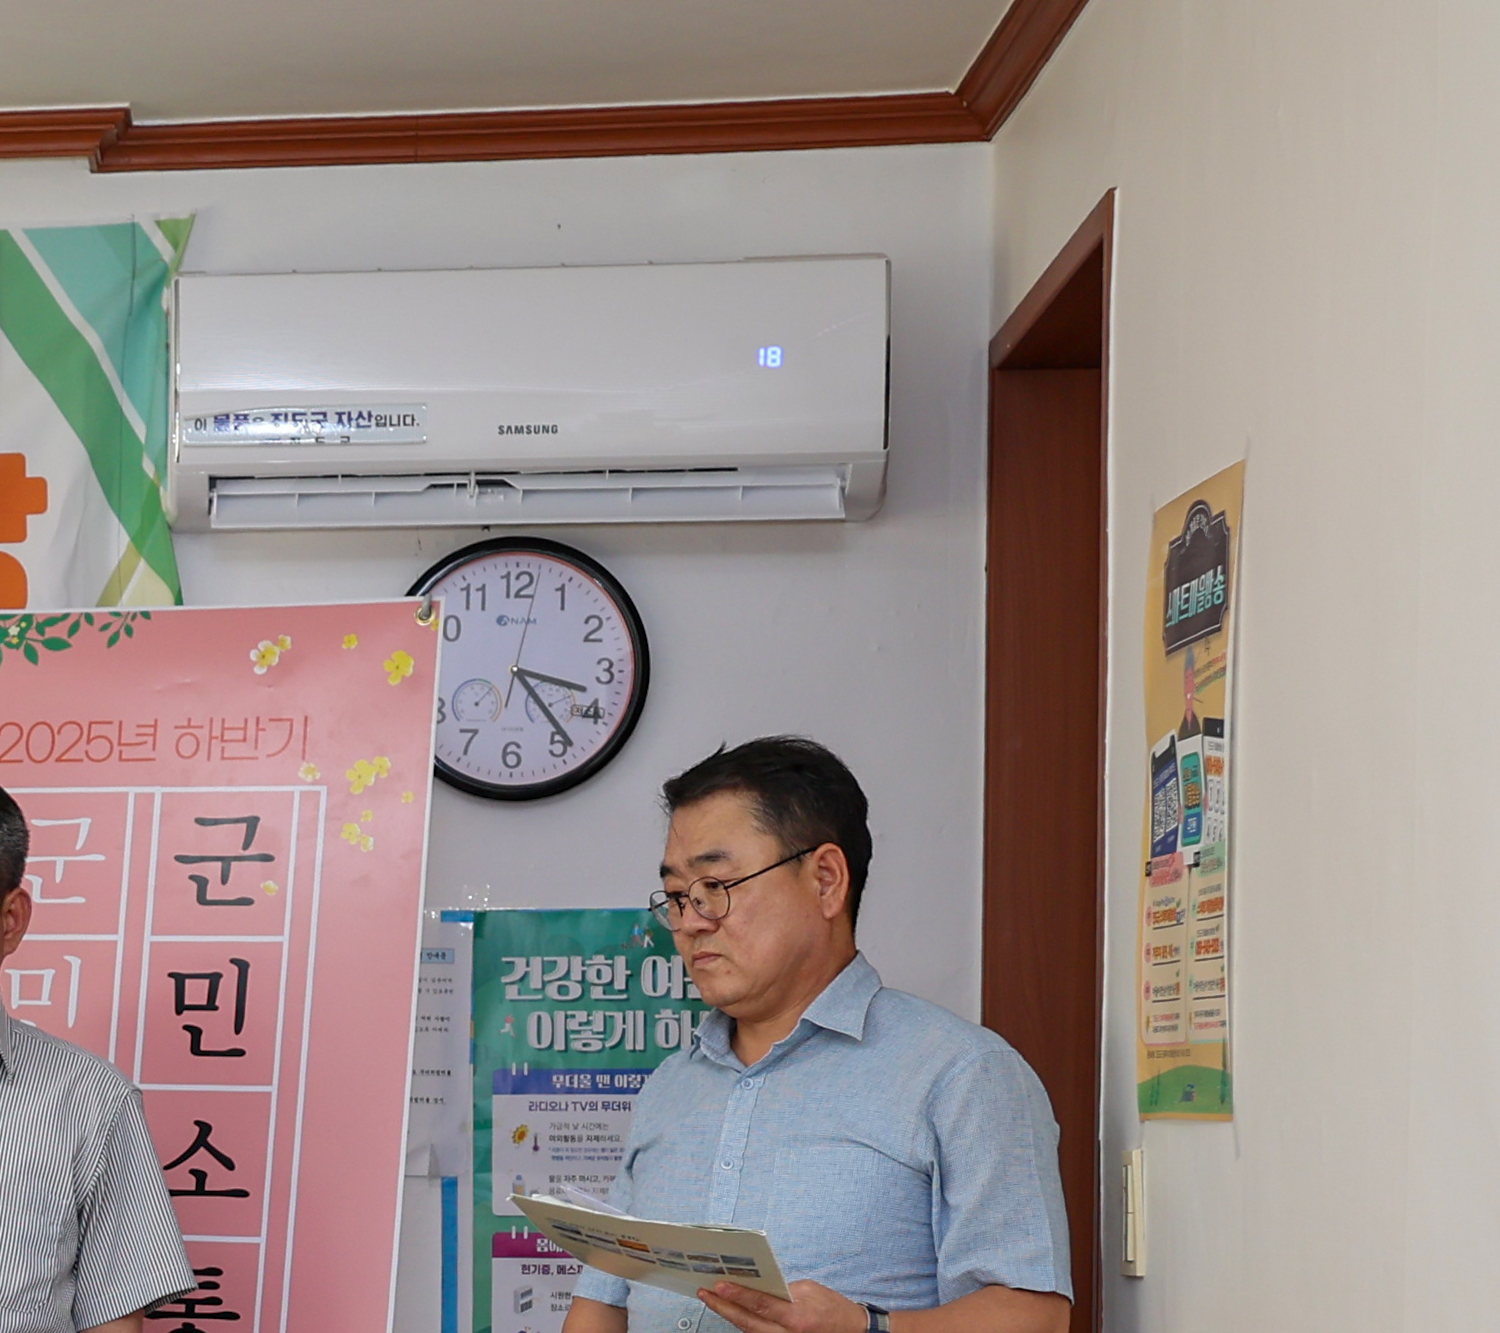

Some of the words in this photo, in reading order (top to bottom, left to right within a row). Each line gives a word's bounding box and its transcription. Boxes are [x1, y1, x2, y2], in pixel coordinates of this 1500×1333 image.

[757, 345, 784, 368] 18
[498, 423, 559, 437] SAMSUNG
[460, 583, 487, 612] 11
[500, 570, 535, 600] 12
[554, 584, 566, 612] 1
[443, 614, 461, 642] 0
[583, 614, 604, 643] 2
[595, 657, 615, 685] 3
[173, 715, 310, 763] 하반기
[459, 728, 479, 756] 7
[501, 741, 522, 769] 6
[500, 953, 632, 1002] 건강한
[641, 953, 701, 1001] 여
[526, 1010, 646, 1053] 이렇게
[528, 1101, 569, 1112] 라디오나
[572, 1101, 598, 1112] TV의
[601, 1101, 632, 1112] 무더위
[521, 1264, 554, 1276] 현기증,
